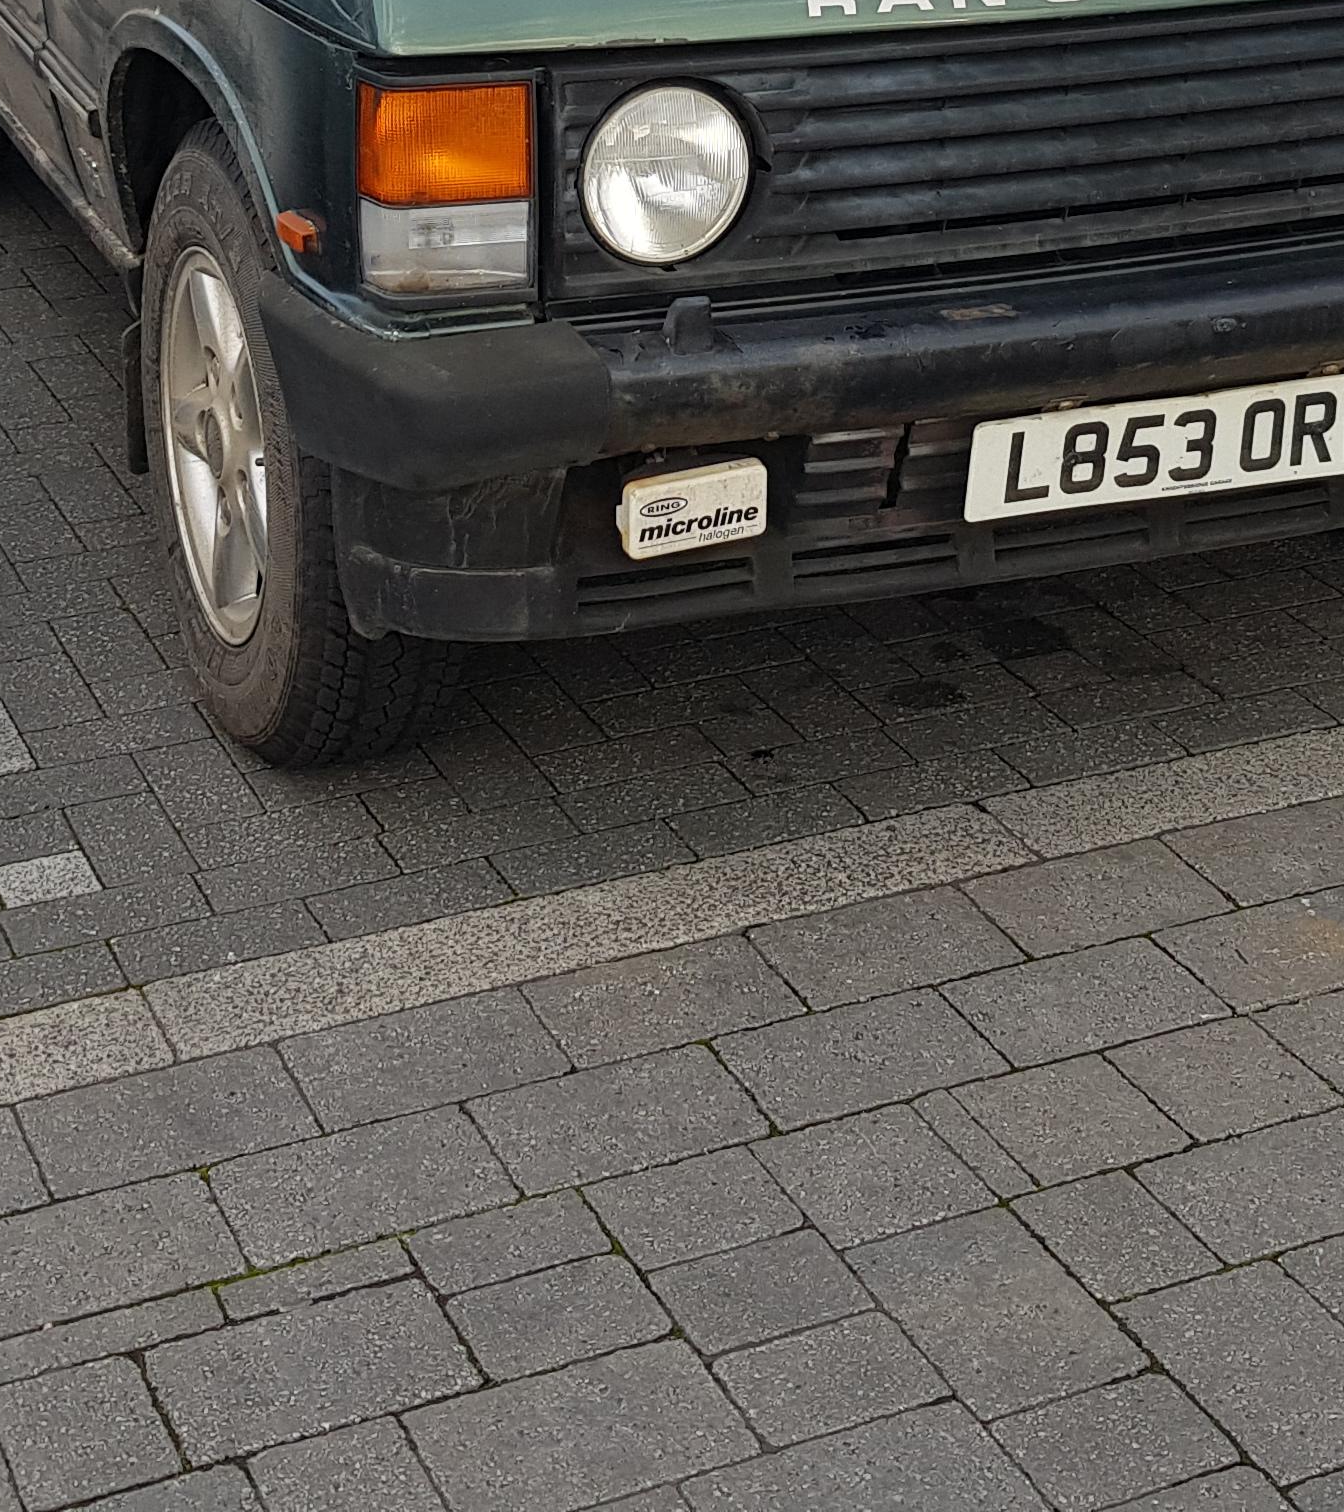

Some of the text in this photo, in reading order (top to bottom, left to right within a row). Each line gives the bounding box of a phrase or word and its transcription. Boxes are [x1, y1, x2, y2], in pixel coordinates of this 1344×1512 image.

[1003, 409, 1217, 504] L853
[647, 501, 681, 514] RING
[639, 506, 759, 543] microline
[699, 525, 745, 542] halogen
